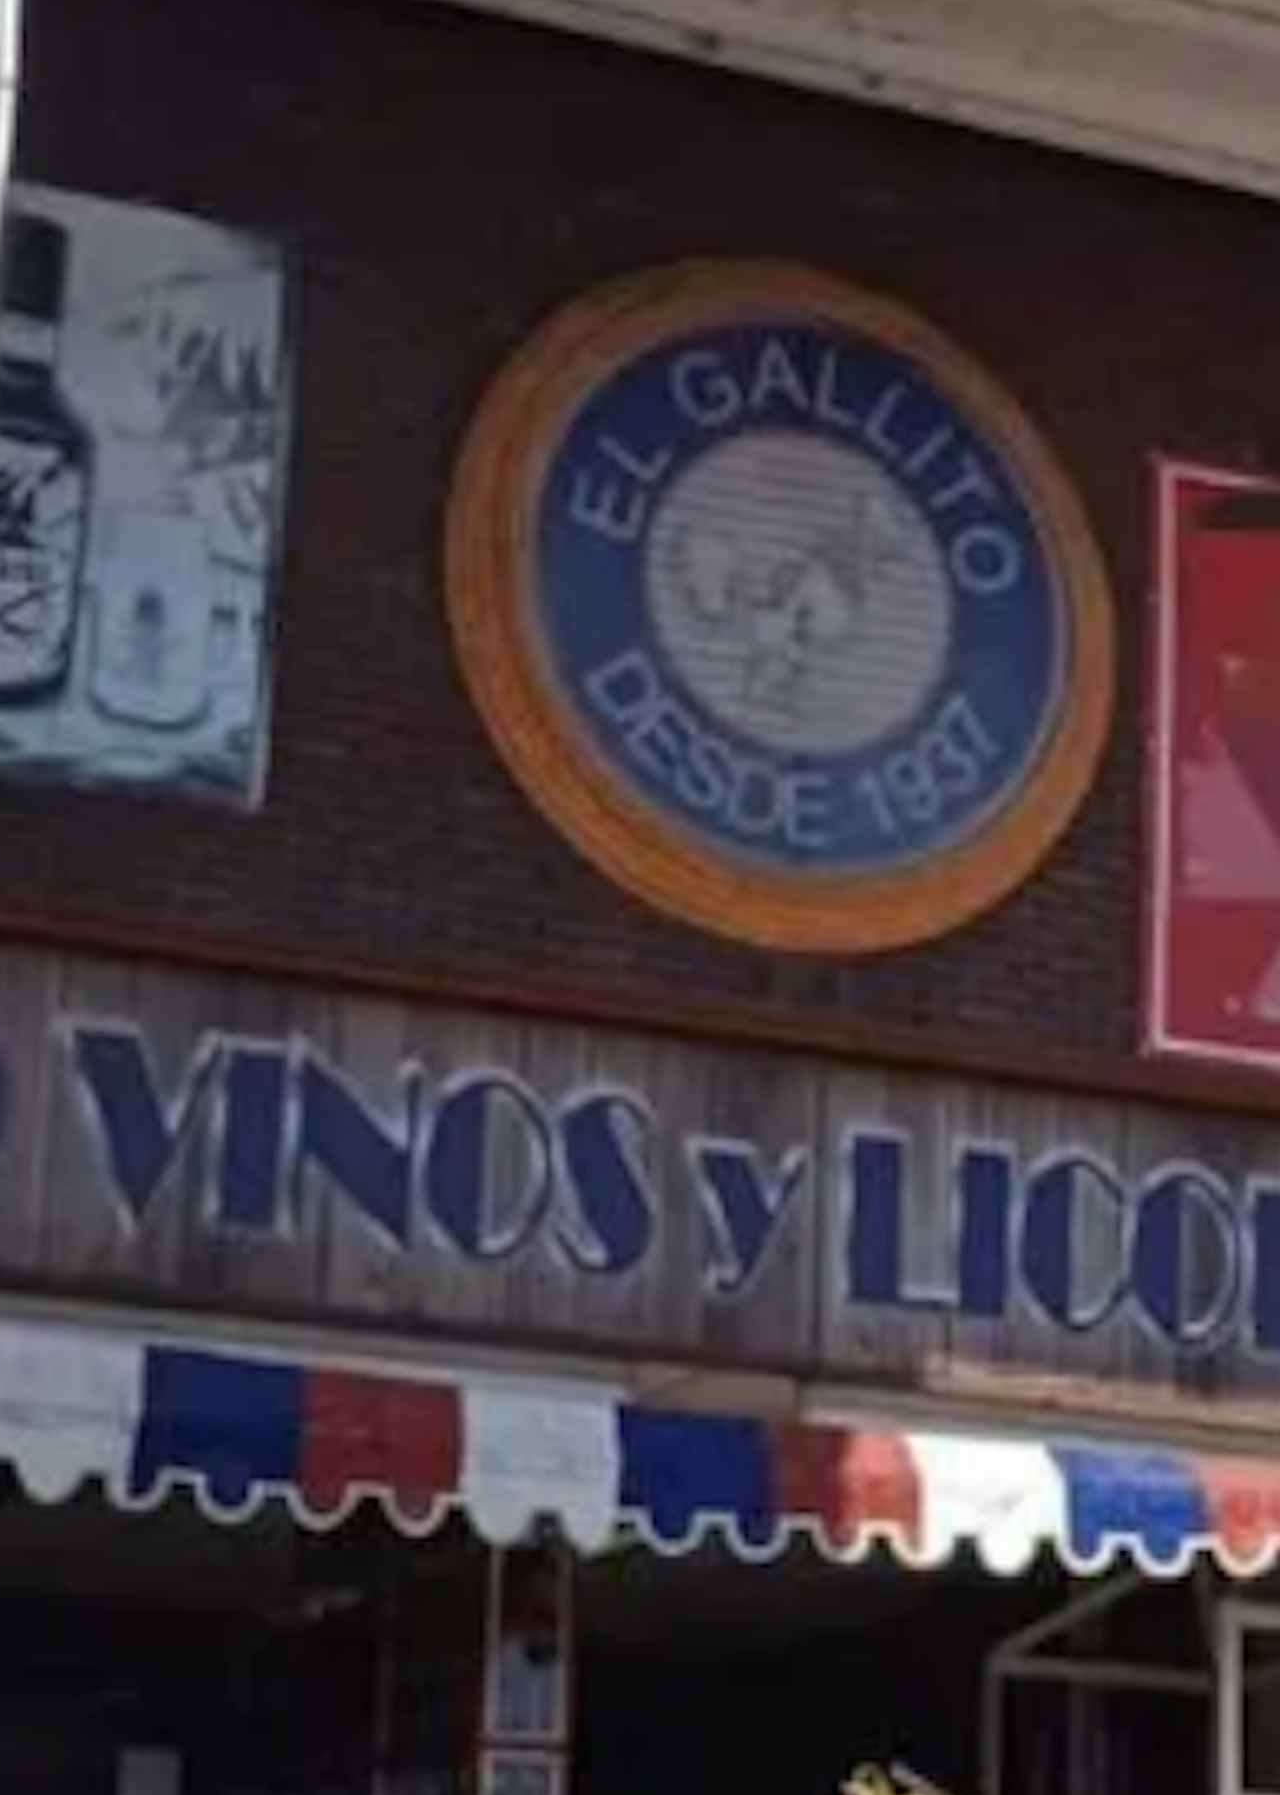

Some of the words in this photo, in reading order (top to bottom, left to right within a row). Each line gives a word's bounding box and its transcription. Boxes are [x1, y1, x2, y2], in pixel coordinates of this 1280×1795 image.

[570, 428, 676, 547] EL
[671, 337, 1020, 594] GALLITO
[586, 647, 823, 845] DESDE
[851, 693, 1001, 834] 1937
[49, 1015, 658, 1277] VINOS
